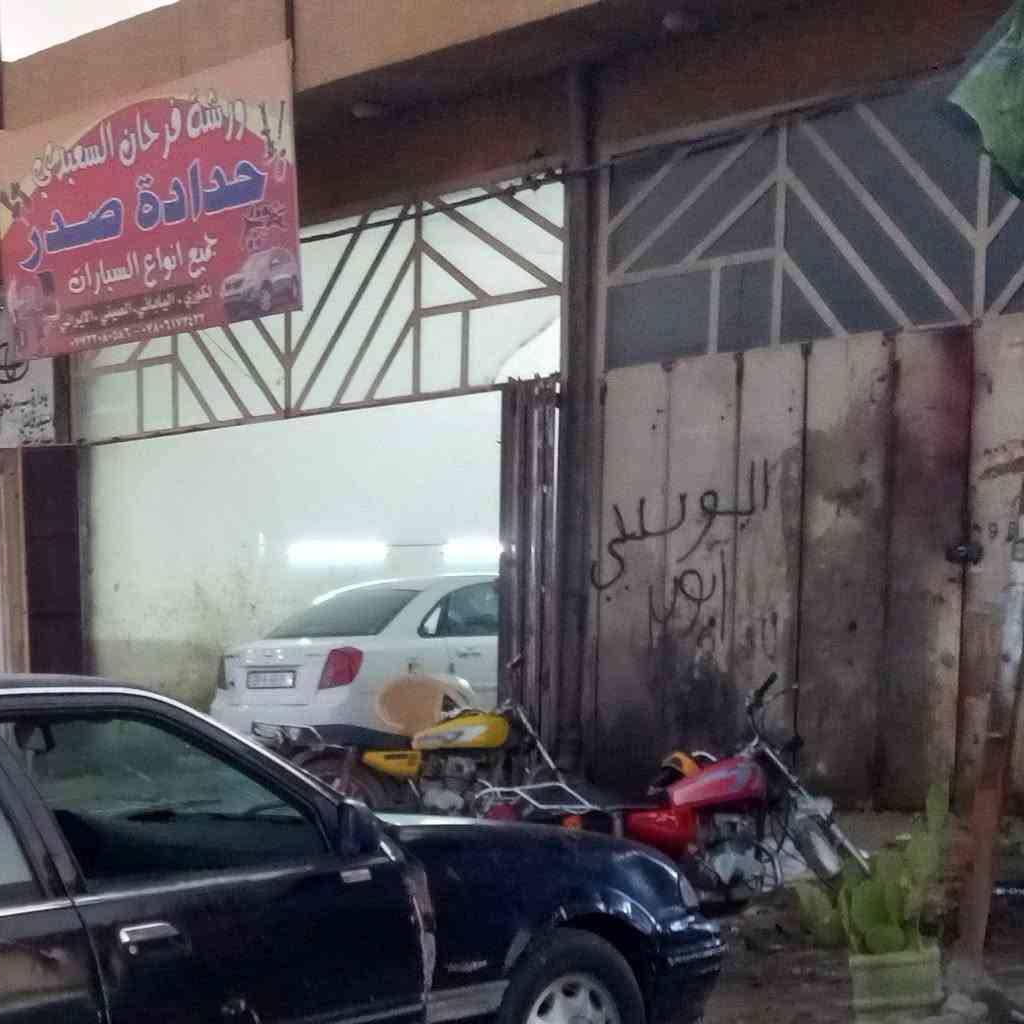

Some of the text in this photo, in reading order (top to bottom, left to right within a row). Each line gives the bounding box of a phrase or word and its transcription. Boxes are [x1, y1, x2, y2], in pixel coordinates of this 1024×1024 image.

[135, 158, 268, 231] حدادة
[17, 196, 125, 272] صدر
[188, 232, 217, 278] جميع
[68, 251, 140, 295] السيارات
